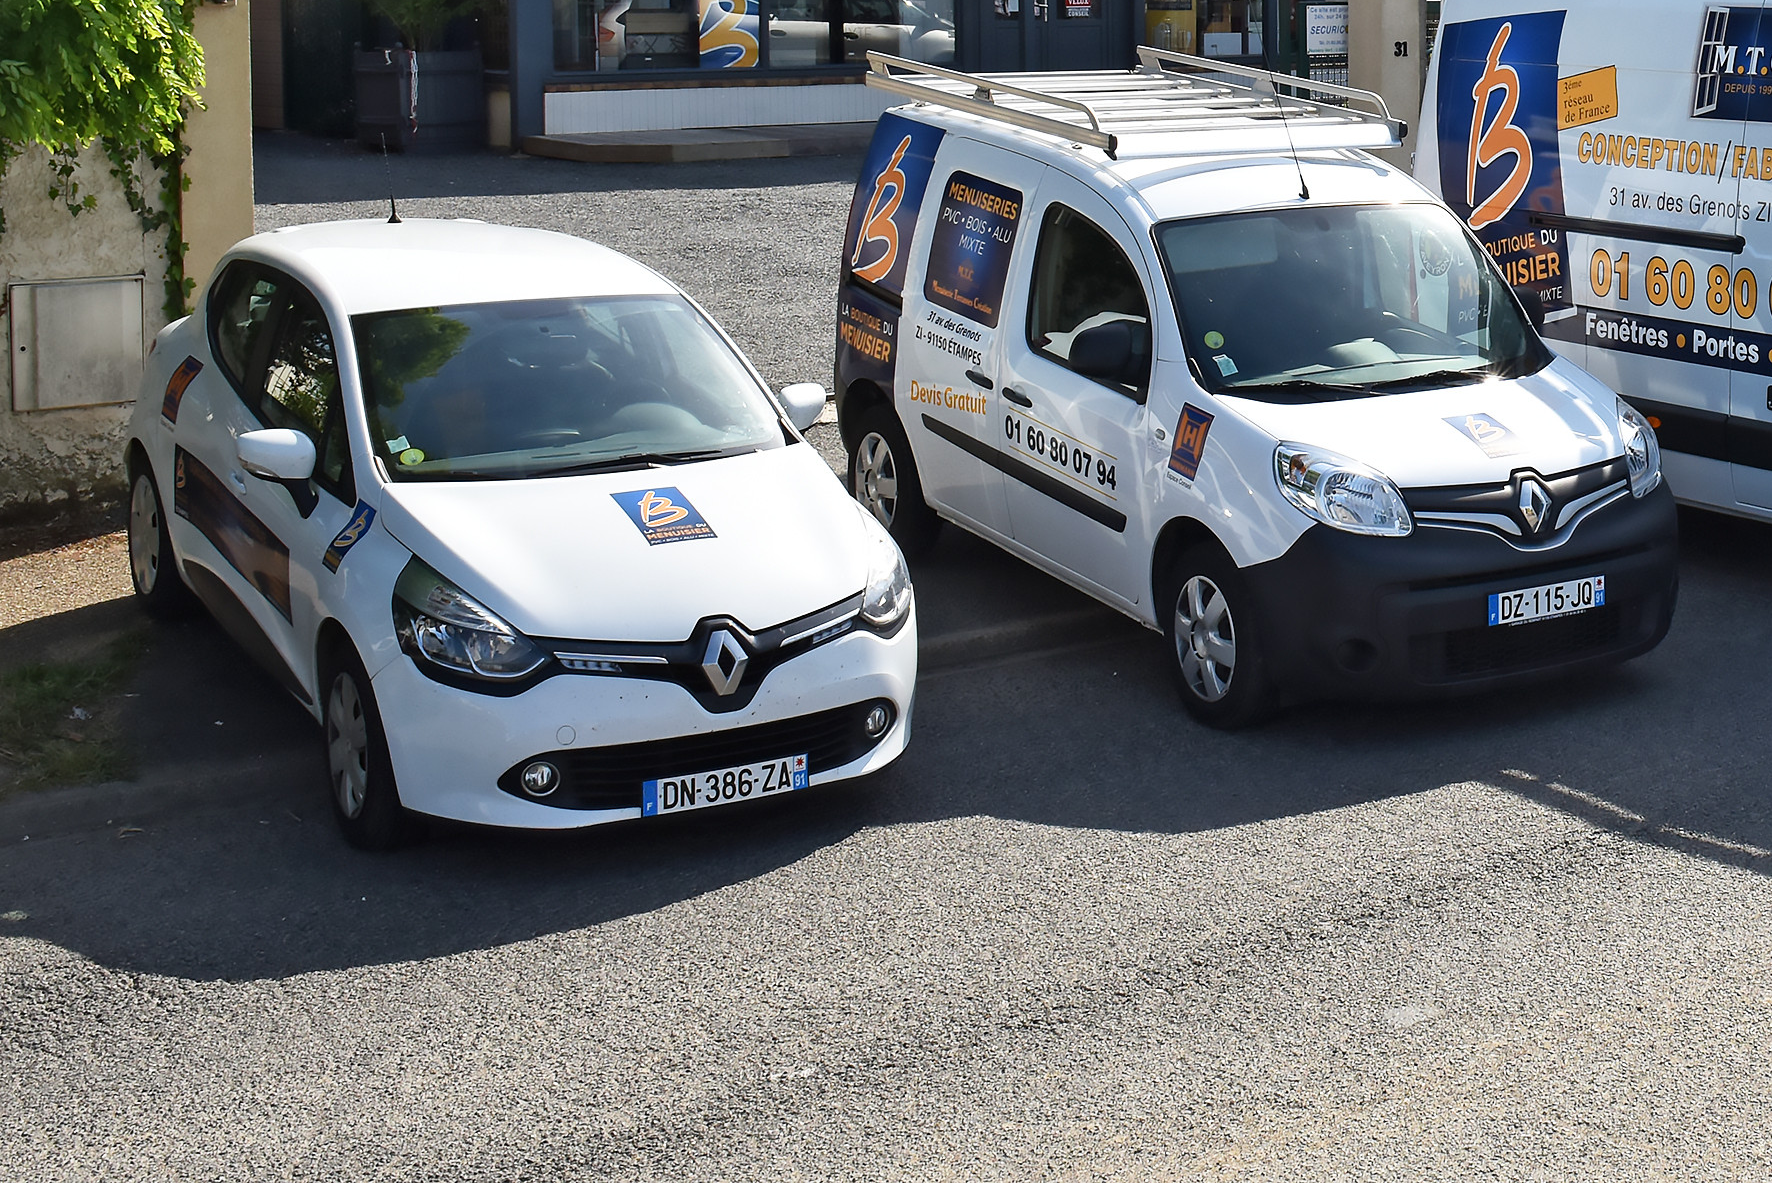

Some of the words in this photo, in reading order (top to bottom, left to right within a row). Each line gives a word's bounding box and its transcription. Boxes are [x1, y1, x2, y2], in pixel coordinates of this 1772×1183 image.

[1394, 41, 1408, 57] 31
[1563, 93, 1594, 109] réseau
[1724, 82, 1756, 95] DEPUIS
[1564, 110, 1576, 124] de
[1578, 102, 1611, 121] France
[949, 182, 1019, 220] MENUISERIES
[1608, 187, 1627, 207] 31
[1632, 195, 1651, 211] av.
[1656, 191, 1683, 213] des
[1688, 194, 1751, 221] Grenots
[1756, 201, 1771, 223] ZI
[943, 207, 961, 225] PVC
[965, 215, 987, 234] BOIS
[992, 225, 1013, 244] ALU
[1540, 229, 1558, 245] DU
[958, 233, 986, 255] MIXTE
[1590, 248, 1630, 301] 01
[1645, 255, 1695, 310] 60
[1706, 264, 1758, 319] 80
[841, 302, 850, 316] LA
[851, 307, 881, 332] BOUTIQUE
[882, 321, 893, 336] DU
[926, 310, 935, 323] 31
[935, 315, 944, 327] av.
[943, 317, 956, 332] des
[955, 322, 982, 343] Grenots
[840, 320, 892, 363] MENUISIER
[915, 325, 923, 340] ZI
[927, 331, 948, 351] 91150
[947, 337, 982, 366] ÉTAMPES
[1585, 312, 1669, 349] Fenêtres
[1692, 329, 1760, 365] Portes
[910, 380, 941, 407] Devis
[944, 387, 987, 416] Gratuit
[1005, 415, 1020, 444] 01
[1027, 426, 1045, 455] 60
[1050, 437, 1068, 467] 80
[1073, 448, 1092, 478] 07
[1096, 459, 1117, 491] 94
[646, 527, 711, 540] MENUISIER
[1501, 581, 1592, 620] DZ-115-JQ
[1595, 592, 1604, 603] 91
[646, 802, 653, 811] F
[663, 761, 792, 810] DN-386-ZA
[795, 773, 806, 786] 91
